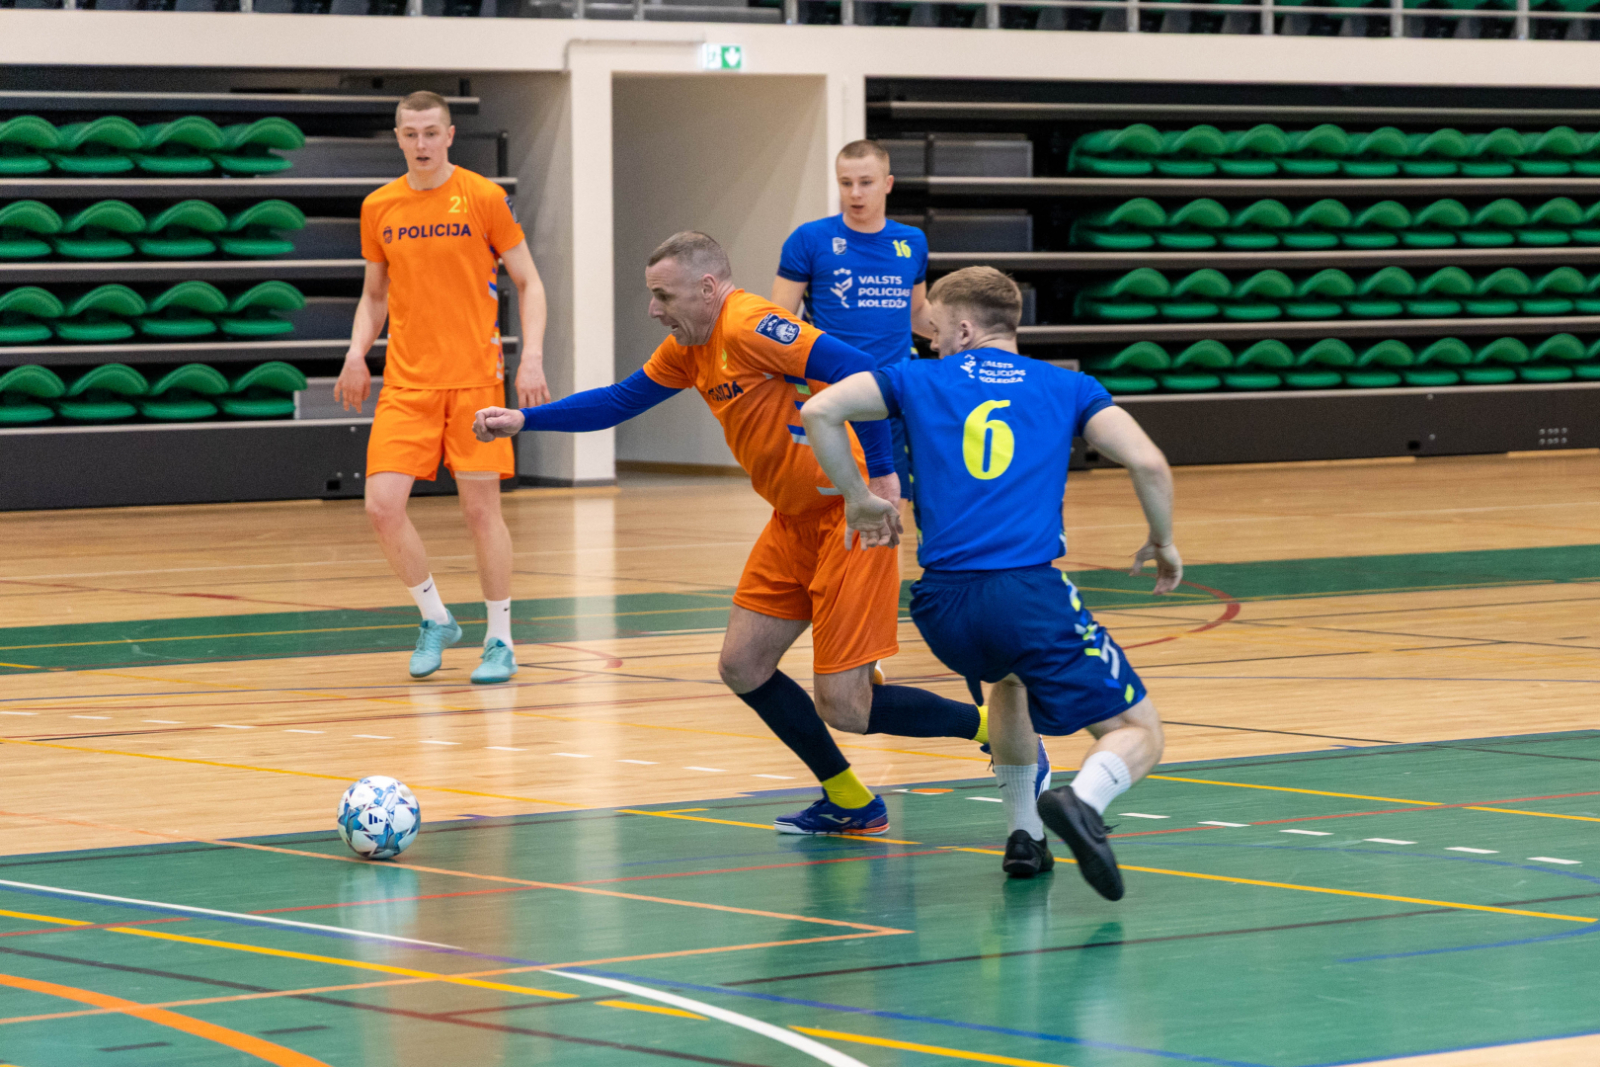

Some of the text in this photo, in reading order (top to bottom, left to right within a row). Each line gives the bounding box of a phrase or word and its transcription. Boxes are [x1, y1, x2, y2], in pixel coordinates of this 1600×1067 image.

[398, 223, 472, 240] POLICIJA
[892, 239, 912, 258] 16
[858, 275, 903, 285] VALSTS
[962, 399, 1015, 480] 6
